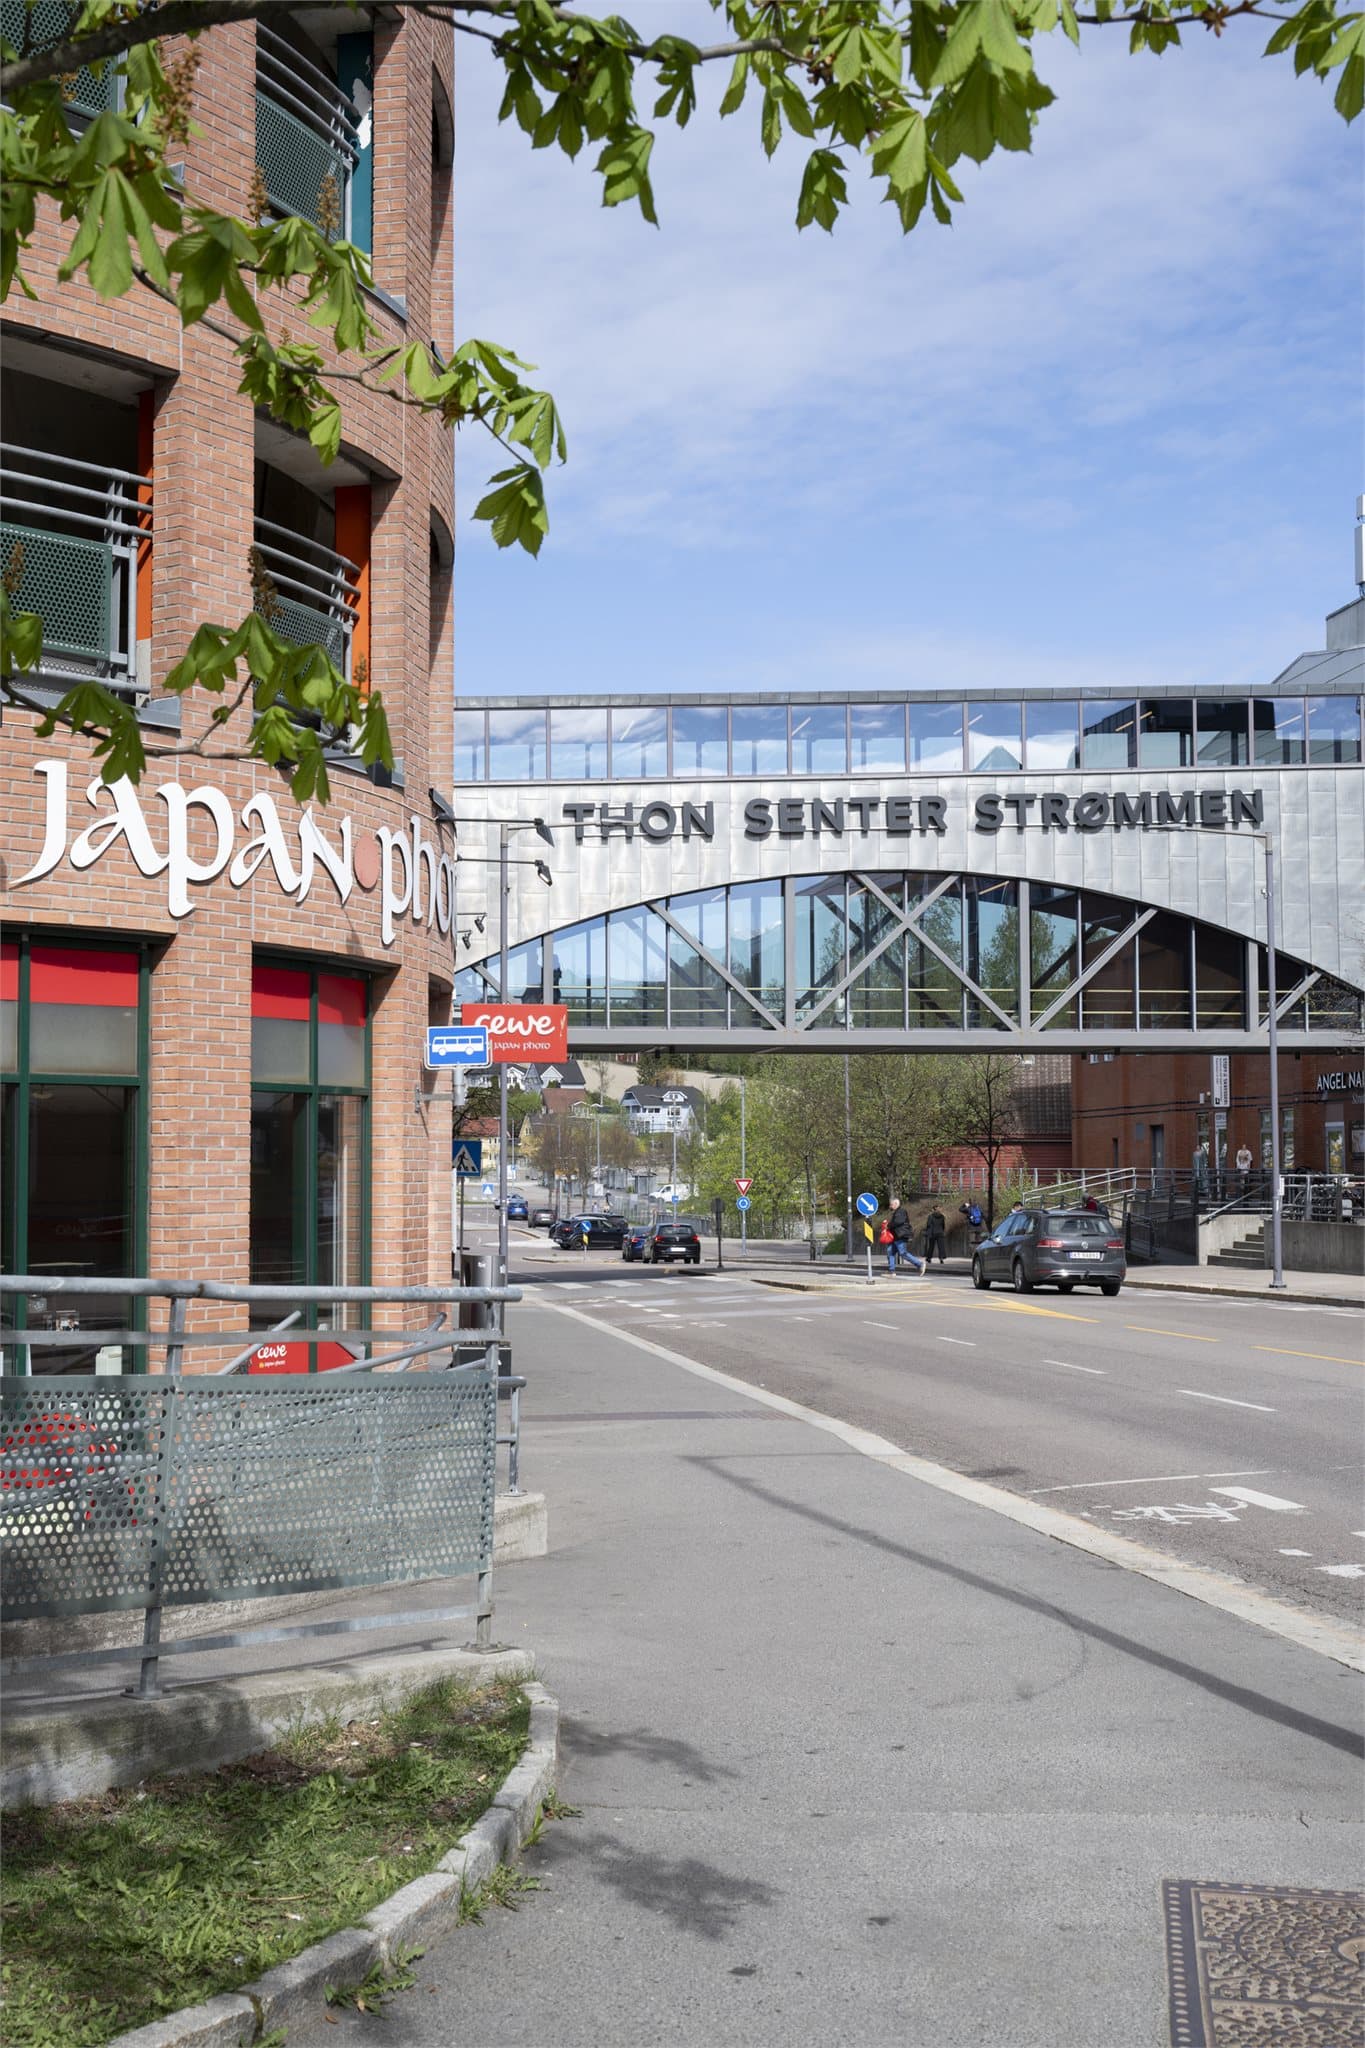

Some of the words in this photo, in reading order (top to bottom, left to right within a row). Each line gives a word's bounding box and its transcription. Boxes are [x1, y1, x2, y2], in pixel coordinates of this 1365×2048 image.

[563, 801, 714, 841] THON
[744, 794, 946, 840] SENTER
[975, 787, 1265, 837] STRØMMEN
[1317, 1071, 1346, 1091] ANGEL
[257, 1344, 288, 1359] cewe
